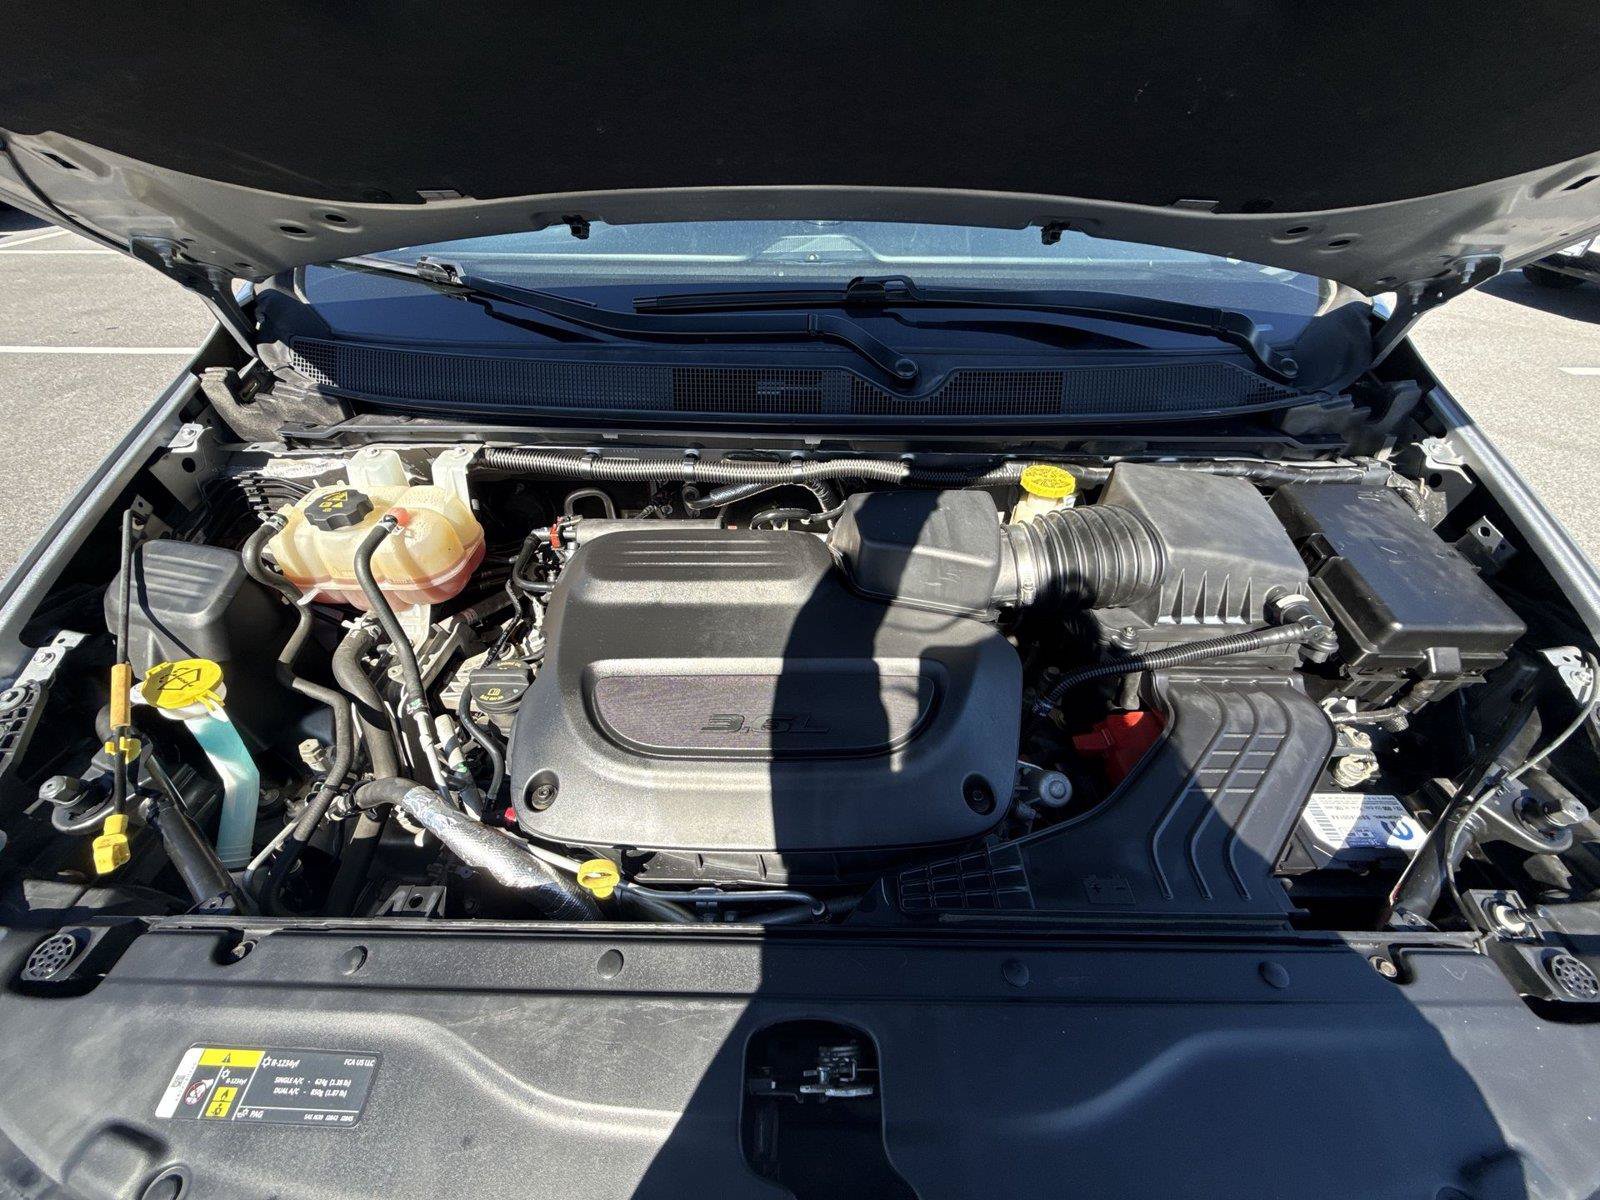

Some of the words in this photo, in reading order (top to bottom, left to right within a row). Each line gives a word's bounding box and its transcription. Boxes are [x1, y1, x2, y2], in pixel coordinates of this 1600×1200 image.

[270, 1058, 300, 1069] R-1234yf
[343, 1058, 355, 1067] FCA
[355, 1059, 364, 1067] US
[364, 1059, 376, 1068] LLC
[293, 1077, 304, 1086] A/C
[288, 1087, 300, 1096] A/C
[249, 1109, 264, 1119] PAG
